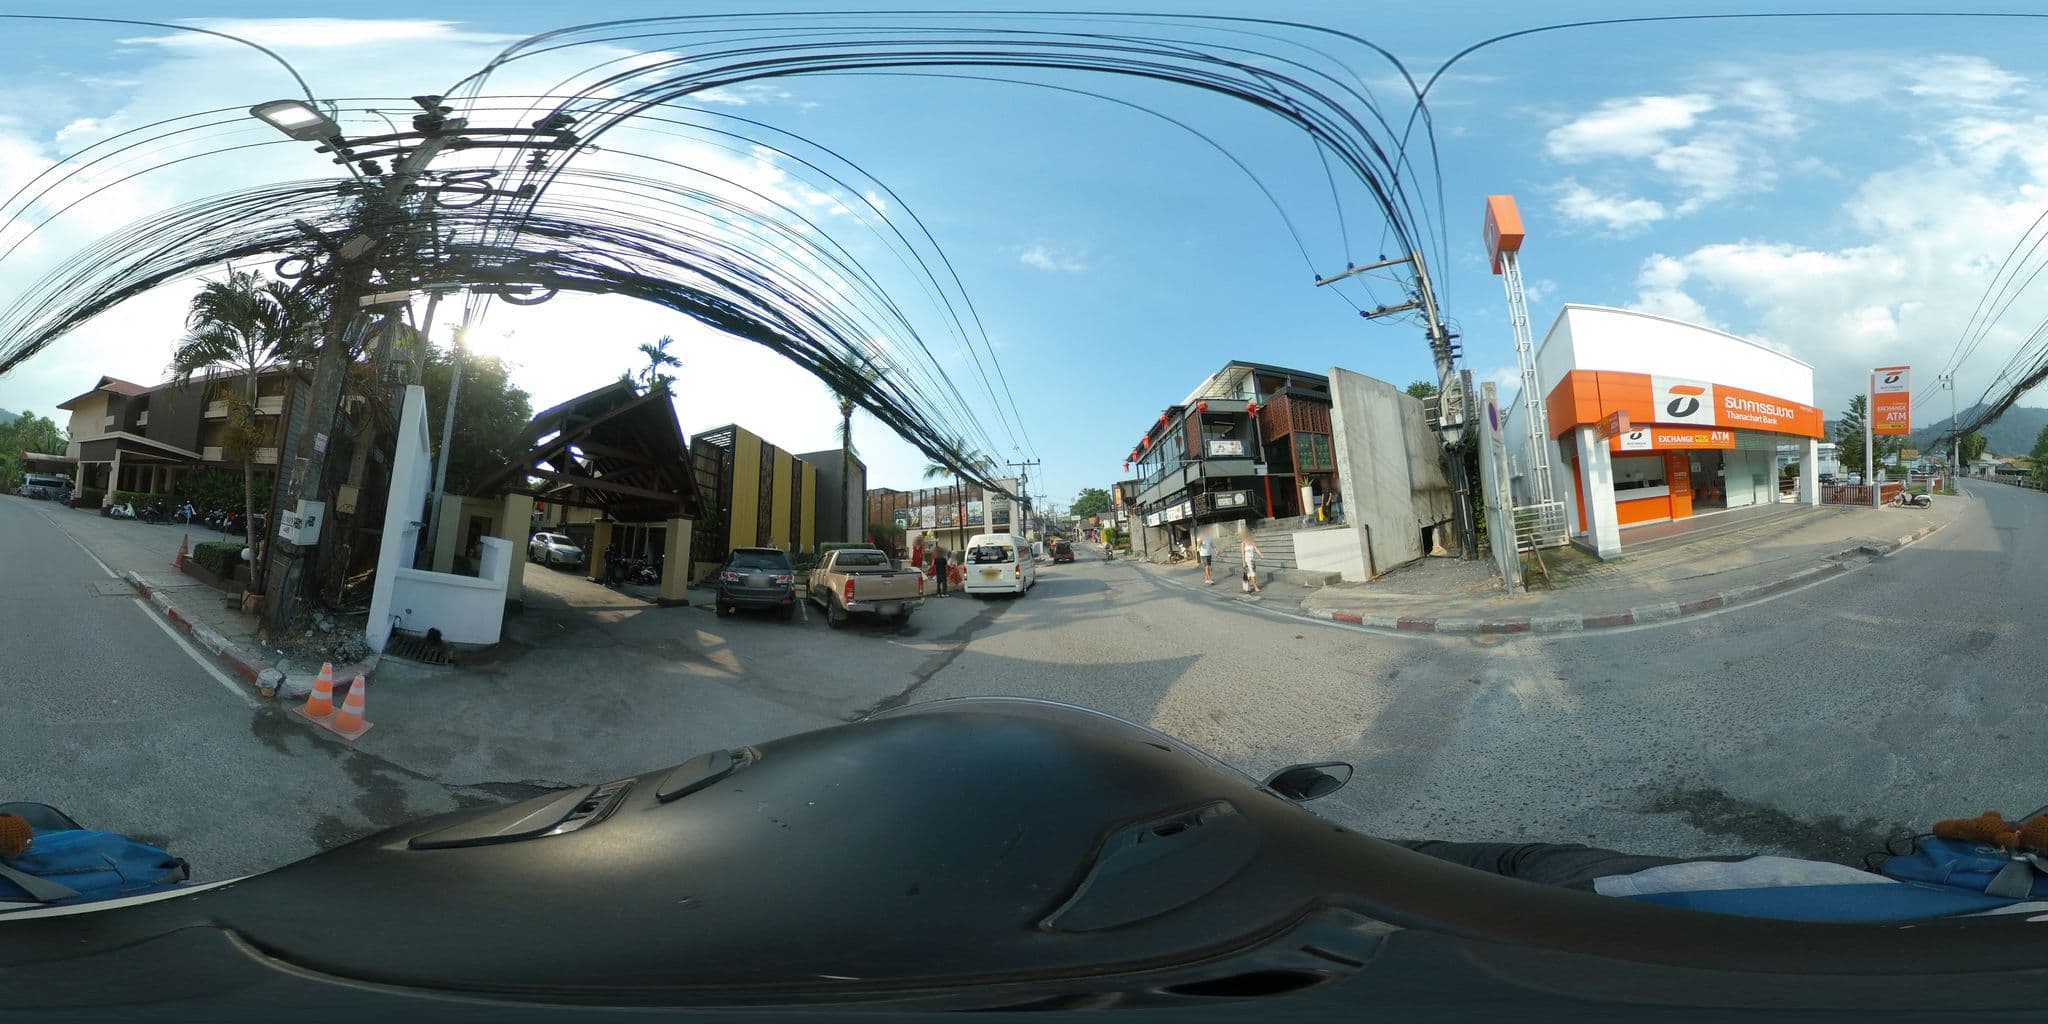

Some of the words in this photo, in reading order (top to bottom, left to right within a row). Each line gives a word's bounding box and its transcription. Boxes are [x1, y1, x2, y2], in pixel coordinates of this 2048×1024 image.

[1727, 411, 1763, 423] Thanachart
[1763, 416, 1777, 424] Bank
[1887, 412, 1906, 421] ATM
[1658, 435, 1694, 443] EXCHANGE
[1711, 432, 1729, 440] ATM
